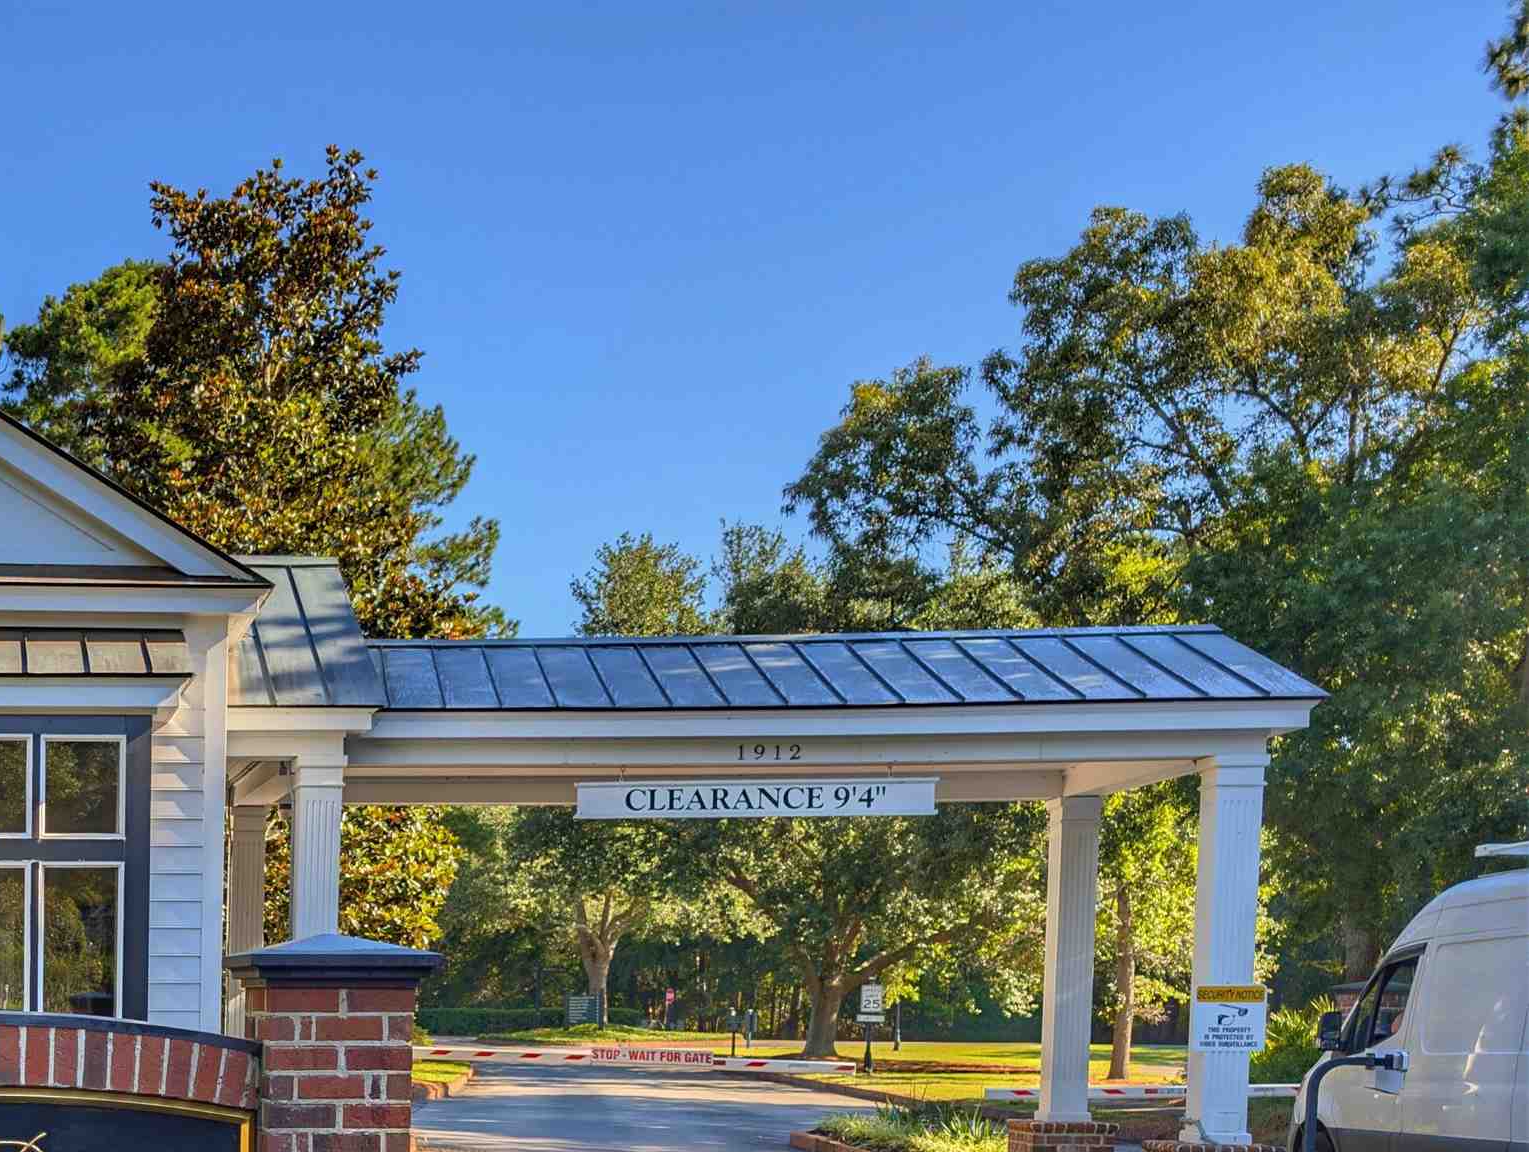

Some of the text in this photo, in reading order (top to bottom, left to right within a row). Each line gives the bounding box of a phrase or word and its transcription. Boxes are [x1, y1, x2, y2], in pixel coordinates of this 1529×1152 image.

[736, 744, 802, 761] 1912
[624, 786, 824, 812] CLEARANCE
[863, 999, 880, 1009] 25
[591, 1049, 620, 1060] STOP
[629, 1051, 655, 1062] WAIT
[660, 1051, 680, 1063] FOR
[684, 1053, 712, 1064] GATE
